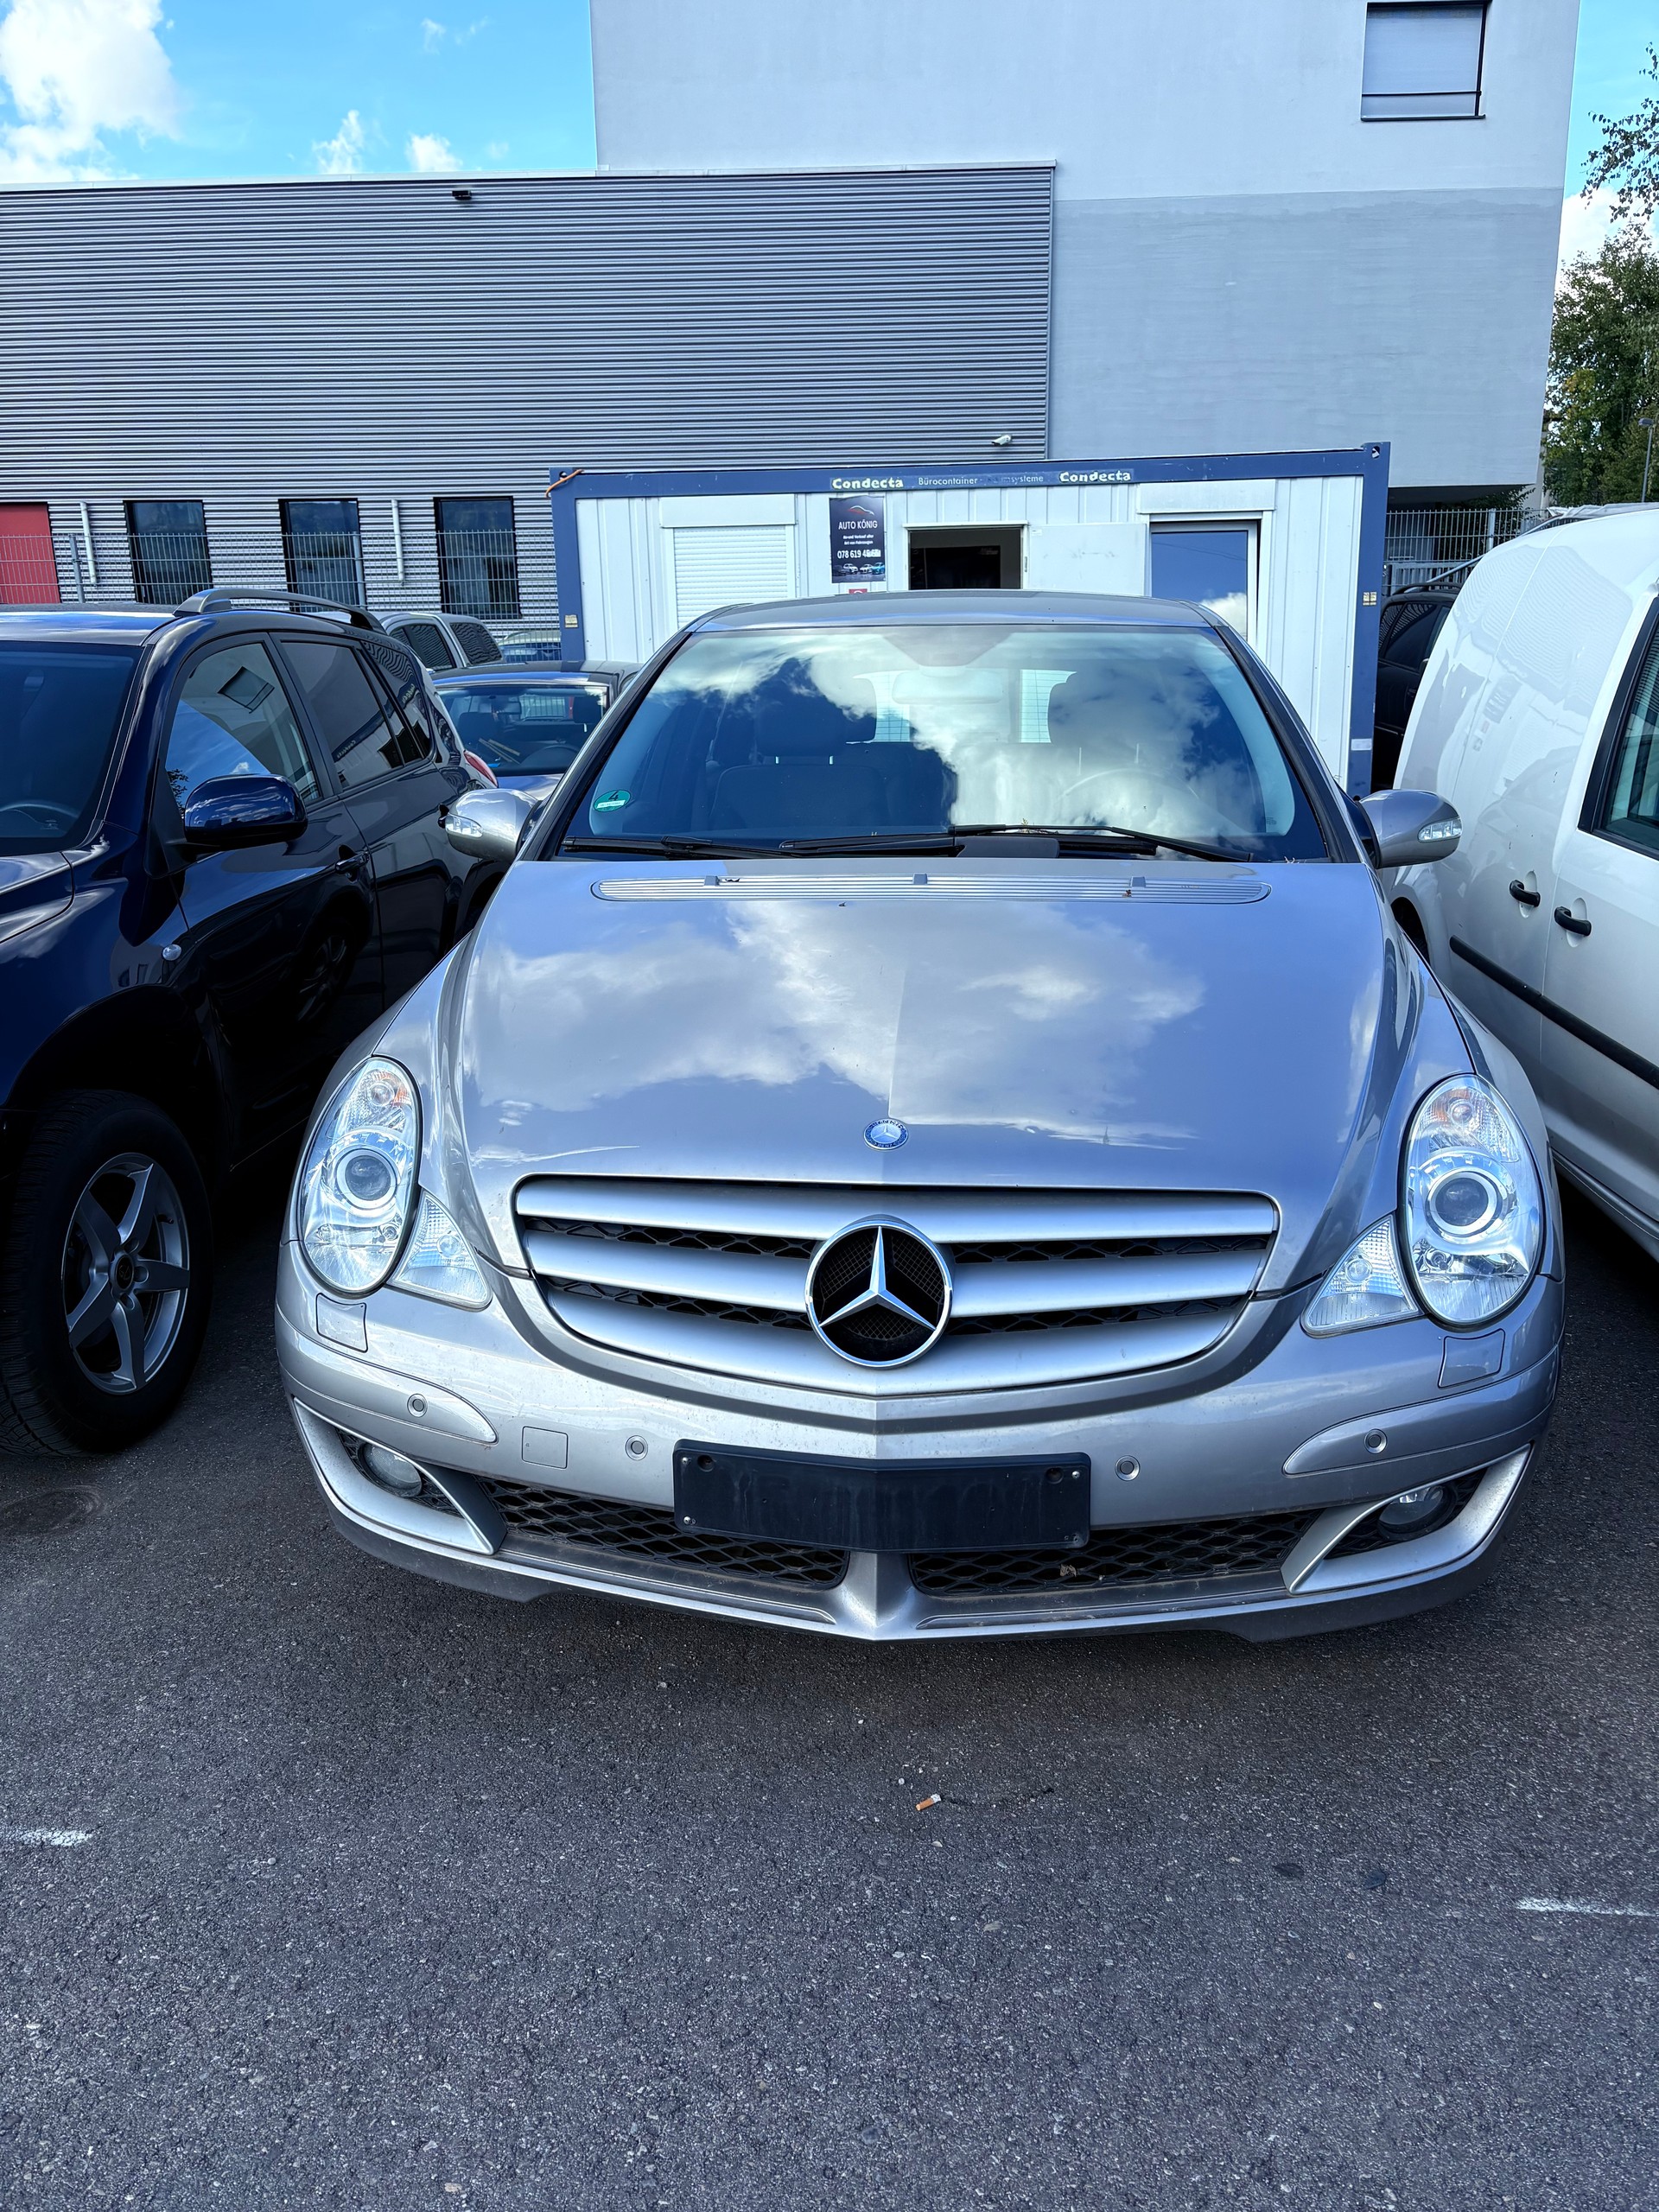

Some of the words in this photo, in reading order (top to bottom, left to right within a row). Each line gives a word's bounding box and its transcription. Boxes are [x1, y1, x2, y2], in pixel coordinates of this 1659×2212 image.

[918, 477, 978, 486] Bürocontainer
[1059, 470, 1132, 483] Condecta
[832, 477, 904, 489] Condecta
[857, 519, 878, 529] KÖNIG
[850, 550, 861, 558] 619
[608, 791, 619, 801] 4
